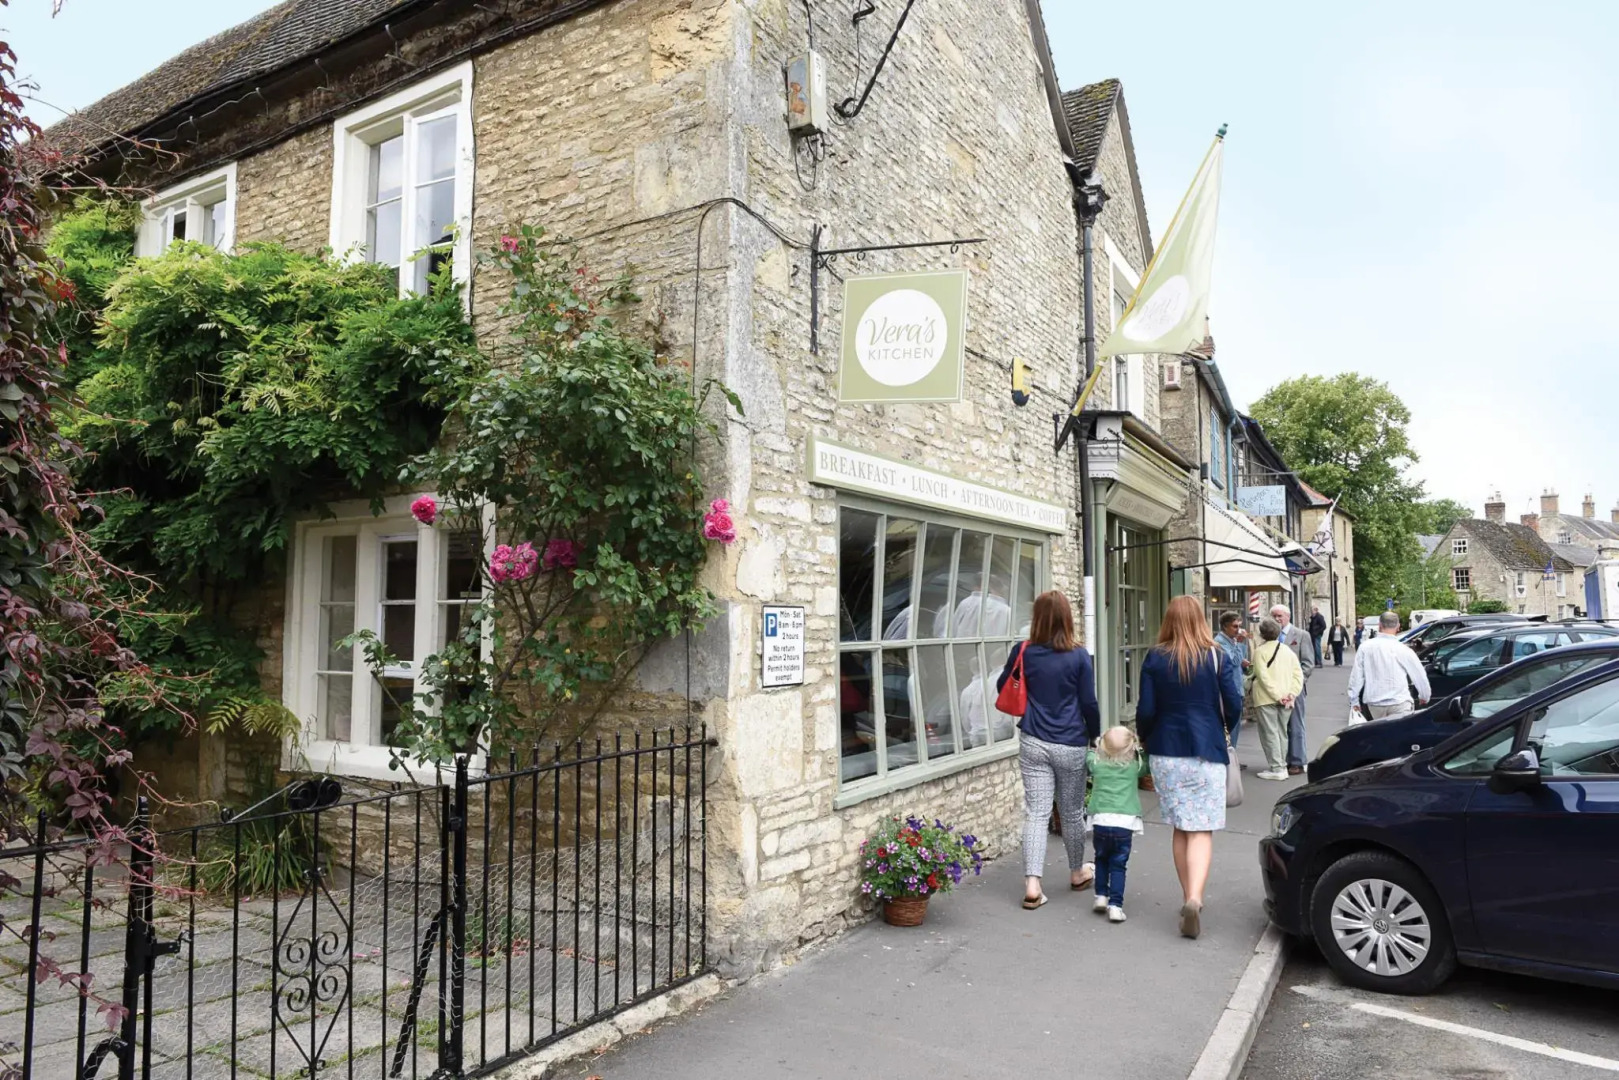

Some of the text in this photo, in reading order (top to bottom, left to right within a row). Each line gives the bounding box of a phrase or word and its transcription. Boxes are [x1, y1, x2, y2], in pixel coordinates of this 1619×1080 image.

[864, 316, 936, 346] Vera's
[868, 347, 934, 361] KITCHEN
[820, 451, 1065, 526] BREAKFAST LUNCH AFTERNOON TEA COFFEE
[779, 610, 790, 618] Mon
[793, 610, 802, 618] Sat
[767, 615, 776, 635] P
[786, 632, 799, 640] hours
[768, 654, 782, 662] within
[786, 653, 800, 661] hours
[767, 664, 801, 672] Permit holders
[775, 674, 793, 682] exempt
